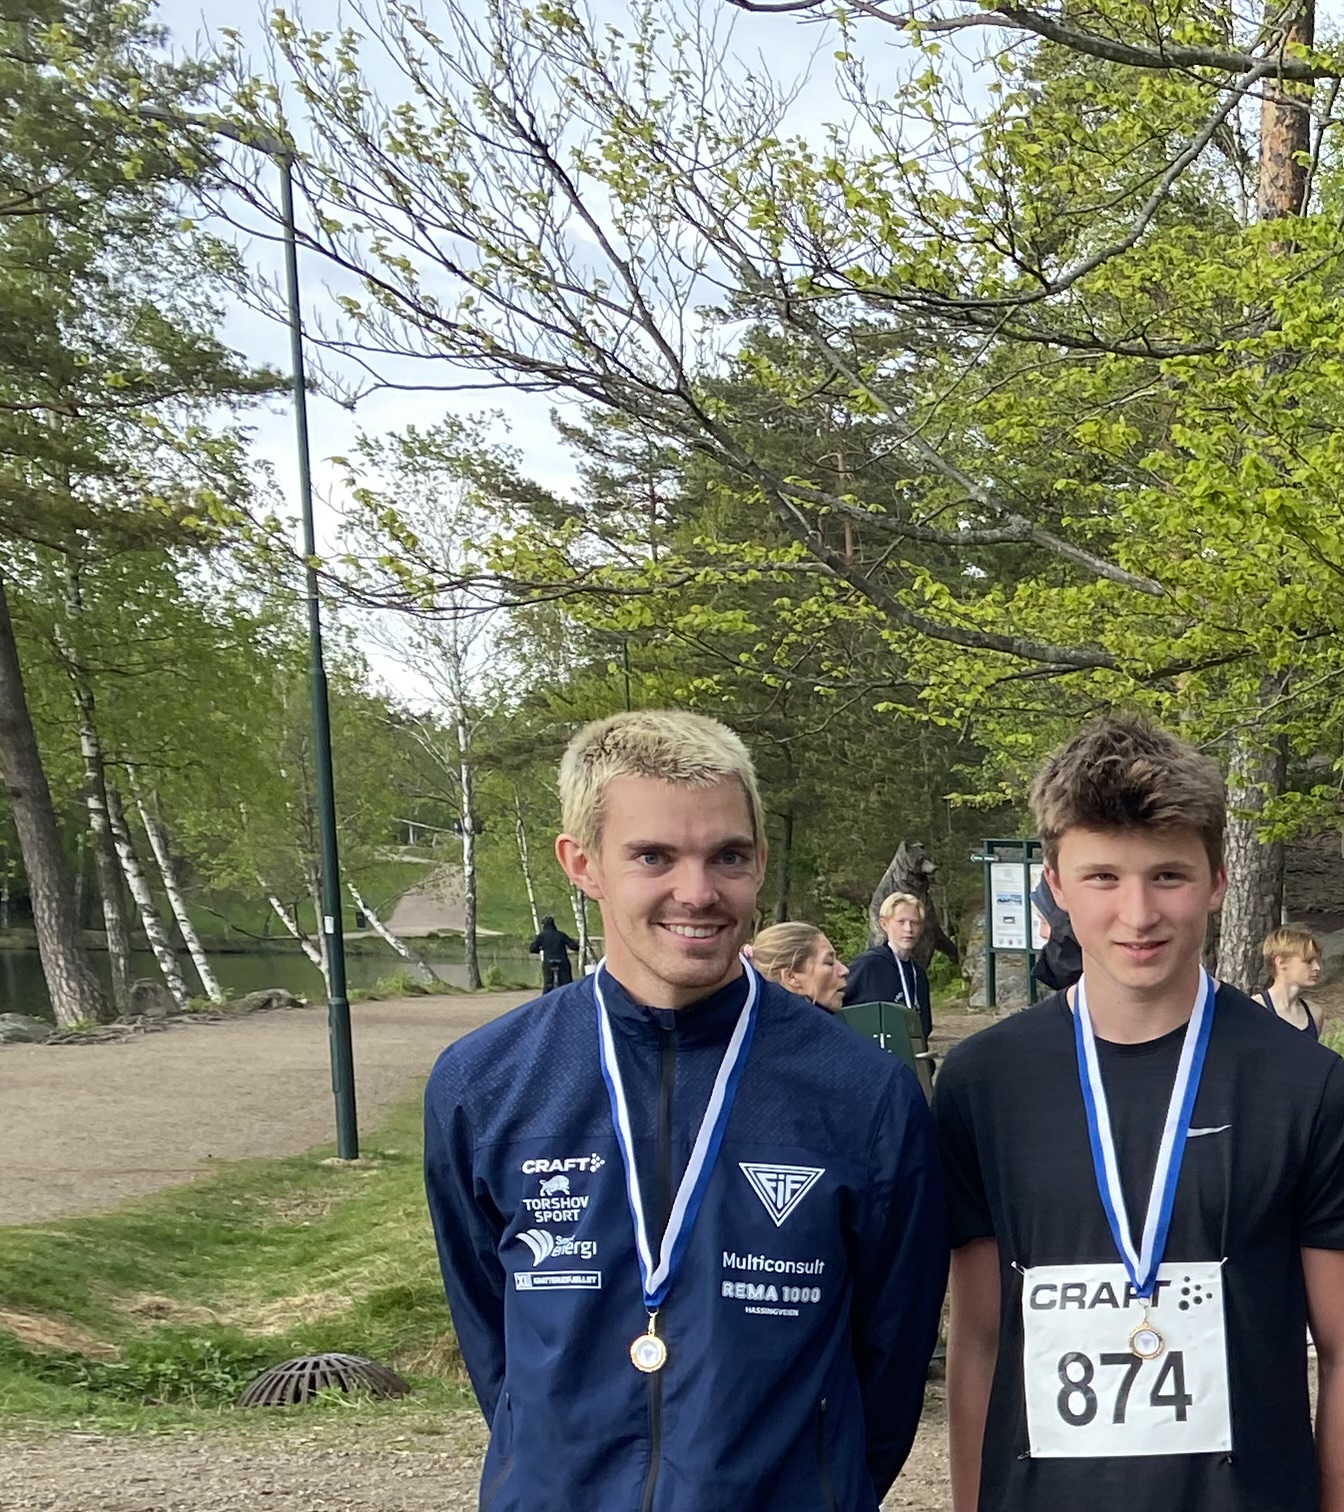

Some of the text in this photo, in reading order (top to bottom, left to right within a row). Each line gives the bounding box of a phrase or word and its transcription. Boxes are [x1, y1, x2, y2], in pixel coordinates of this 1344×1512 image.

[522, 1157, 591, 1174] CRAFT
[522, 1196, 590, 1211] TORSHOV
[534, 1209, 581, 1224] SPORT
[722, 1251, 826, 1275] Multiconsult
[721, 1280, 822, 1303] REMA 1000
[1029, 1279, 1172, 1311] CRAFT
[1056, 1351, 1193, 1428] 874
